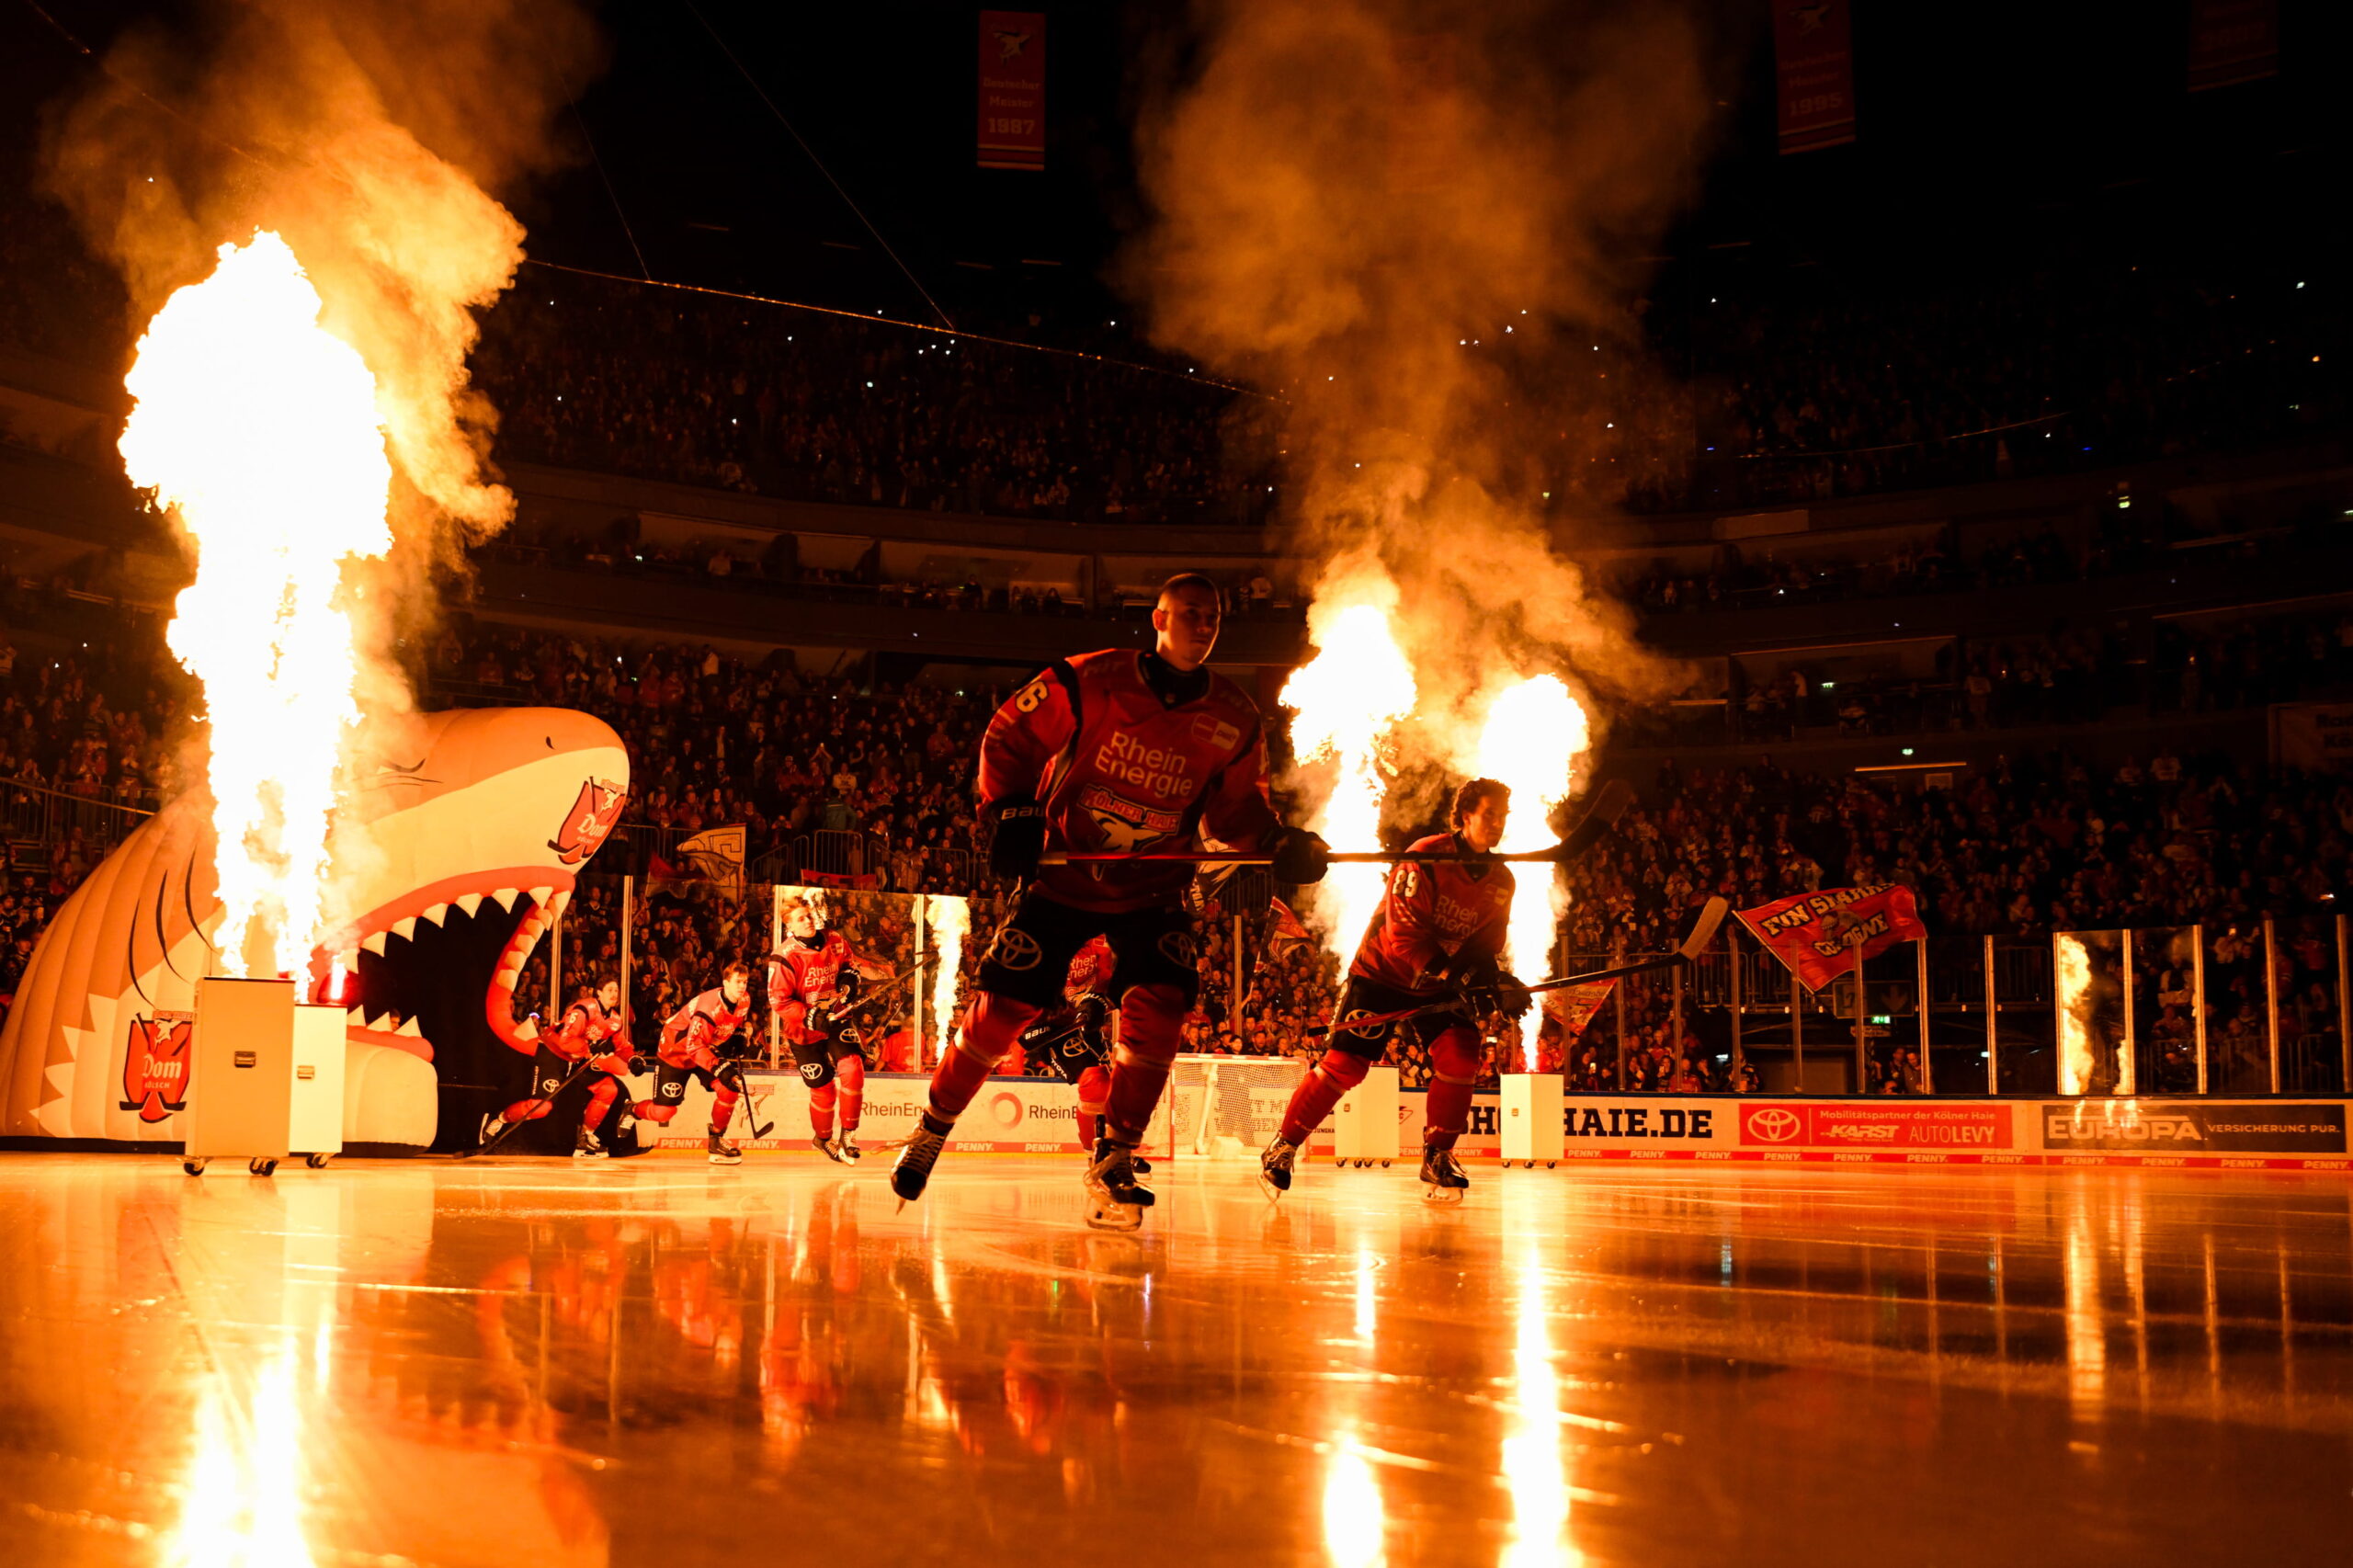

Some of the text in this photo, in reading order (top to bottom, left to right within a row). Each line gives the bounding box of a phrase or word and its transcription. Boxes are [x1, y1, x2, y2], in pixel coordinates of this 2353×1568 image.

[1109, 731, 1188, 774] Rhein
[1095, 744, 1194, 799] Energie
[577, 813, 608, 837] Dom
[1392, 869, 1417, 897] 89
[1760, 903, 1813, 937] FUN
[142, 1053, 182, 1079] Dom
[1820, 1109, 1995, 1120] Mobilitätspartner der Kölner Haie
[1830, 1125, 1900, 1138] KARST
[1909, 1126, 1995, 1142] AUTOLEVY
[2048, 1115, 2340, 1140] EUROPA VERSICHERUNG PUR.
